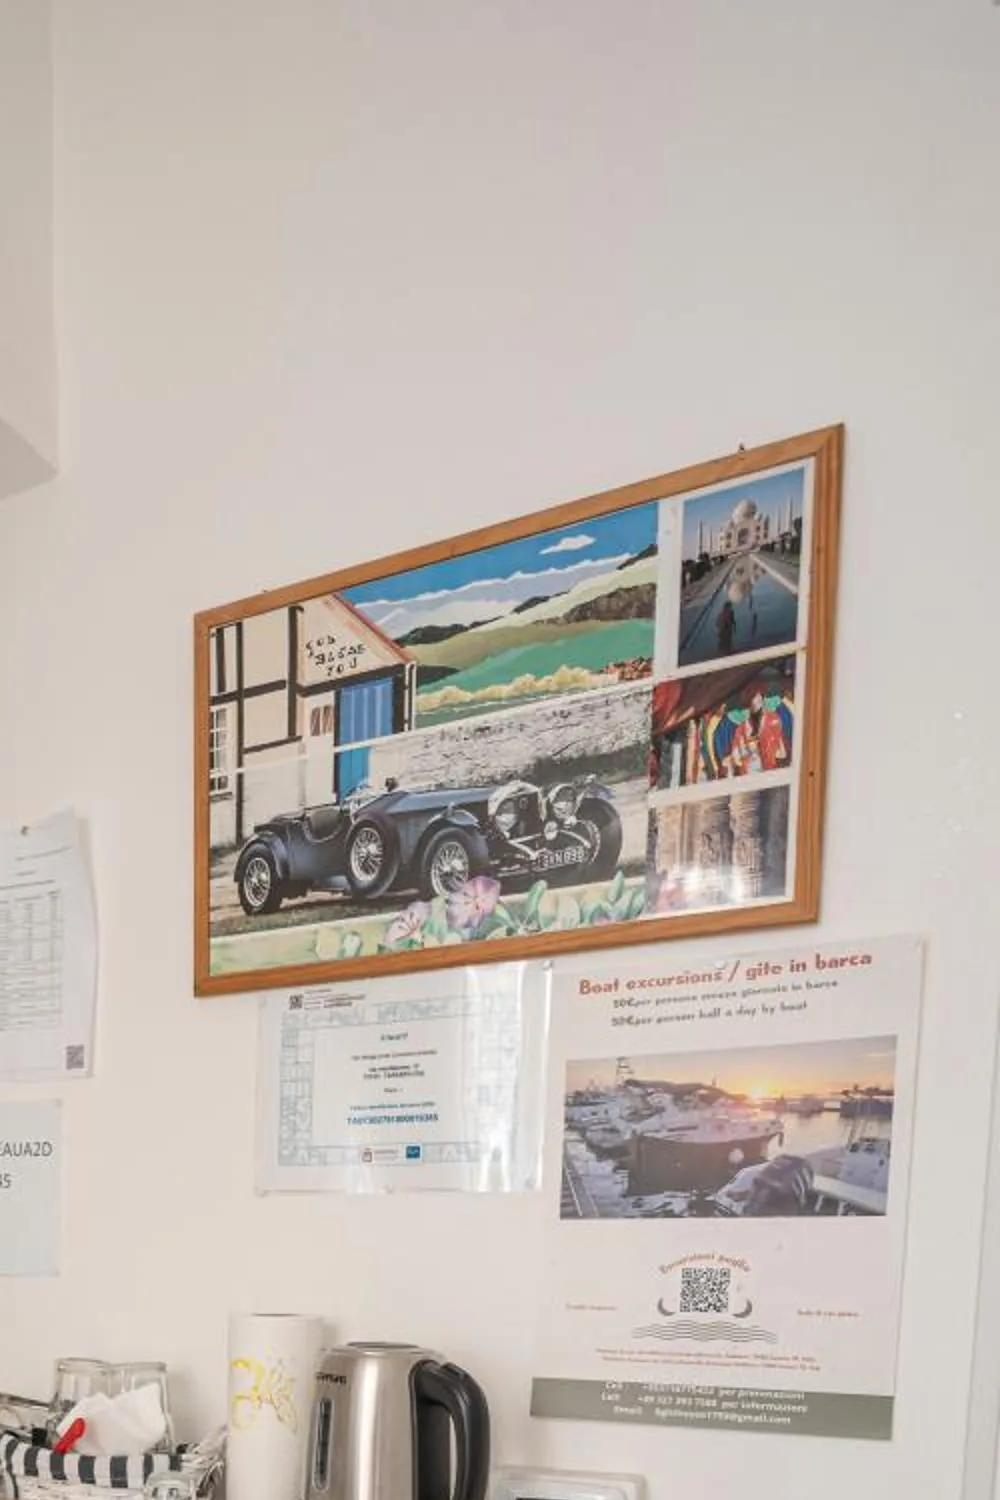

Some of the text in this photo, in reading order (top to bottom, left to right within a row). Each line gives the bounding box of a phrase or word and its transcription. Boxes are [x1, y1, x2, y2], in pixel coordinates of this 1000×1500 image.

[578, 978, 620, 996] Boat
[625, 969, 724, 991] excursions
[745, 961, 783, 982] gite
[789, 958, 807, 974] in
[815, 952, 873, 971] barca
